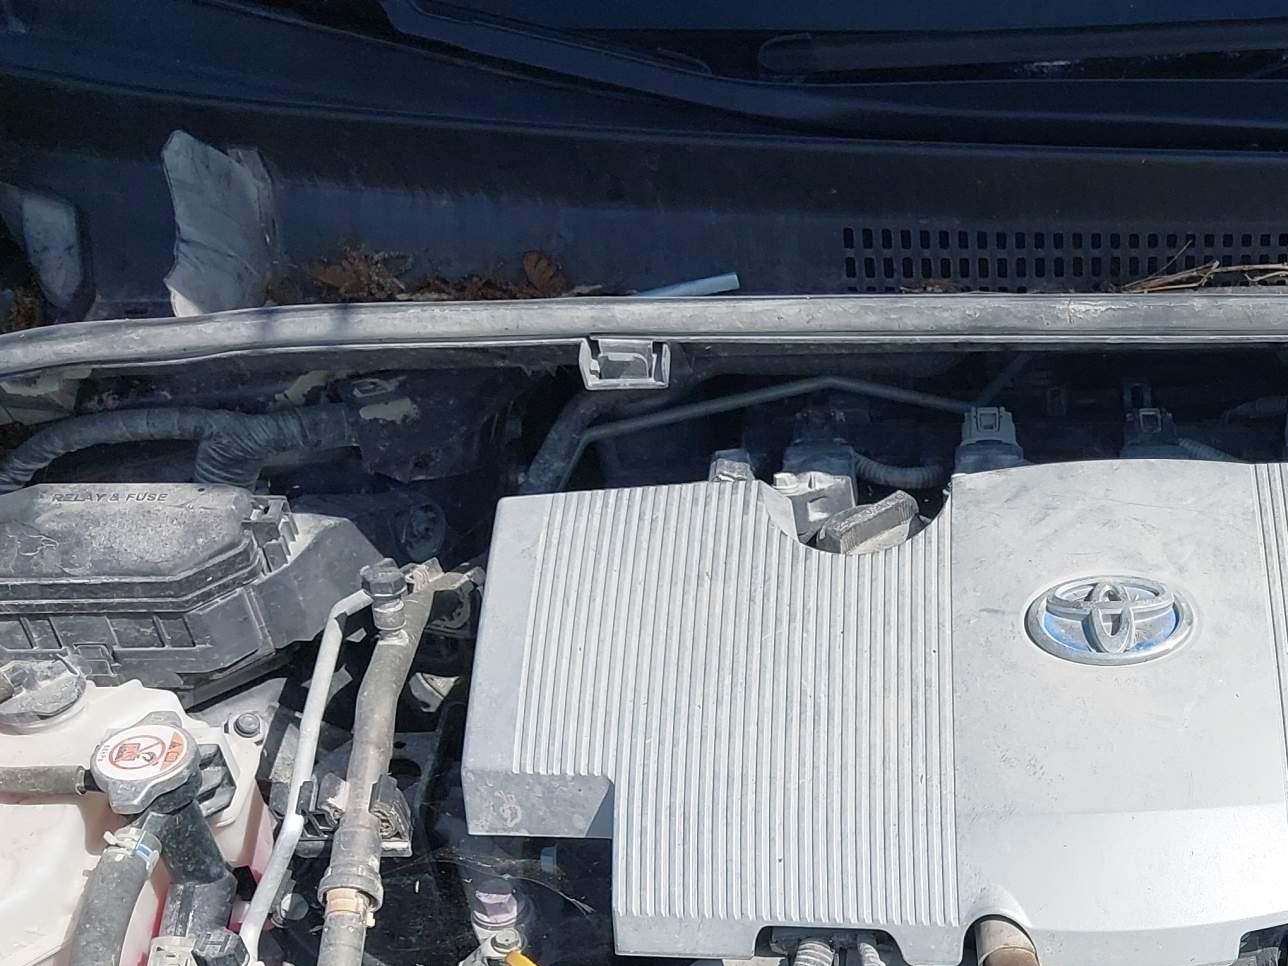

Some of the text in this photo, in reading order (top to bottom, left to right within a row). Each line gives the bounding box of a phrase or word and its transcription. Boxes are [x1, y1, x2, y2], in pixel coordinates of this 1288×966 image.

[52, 492, 168, 502] RELAY & FUSE
